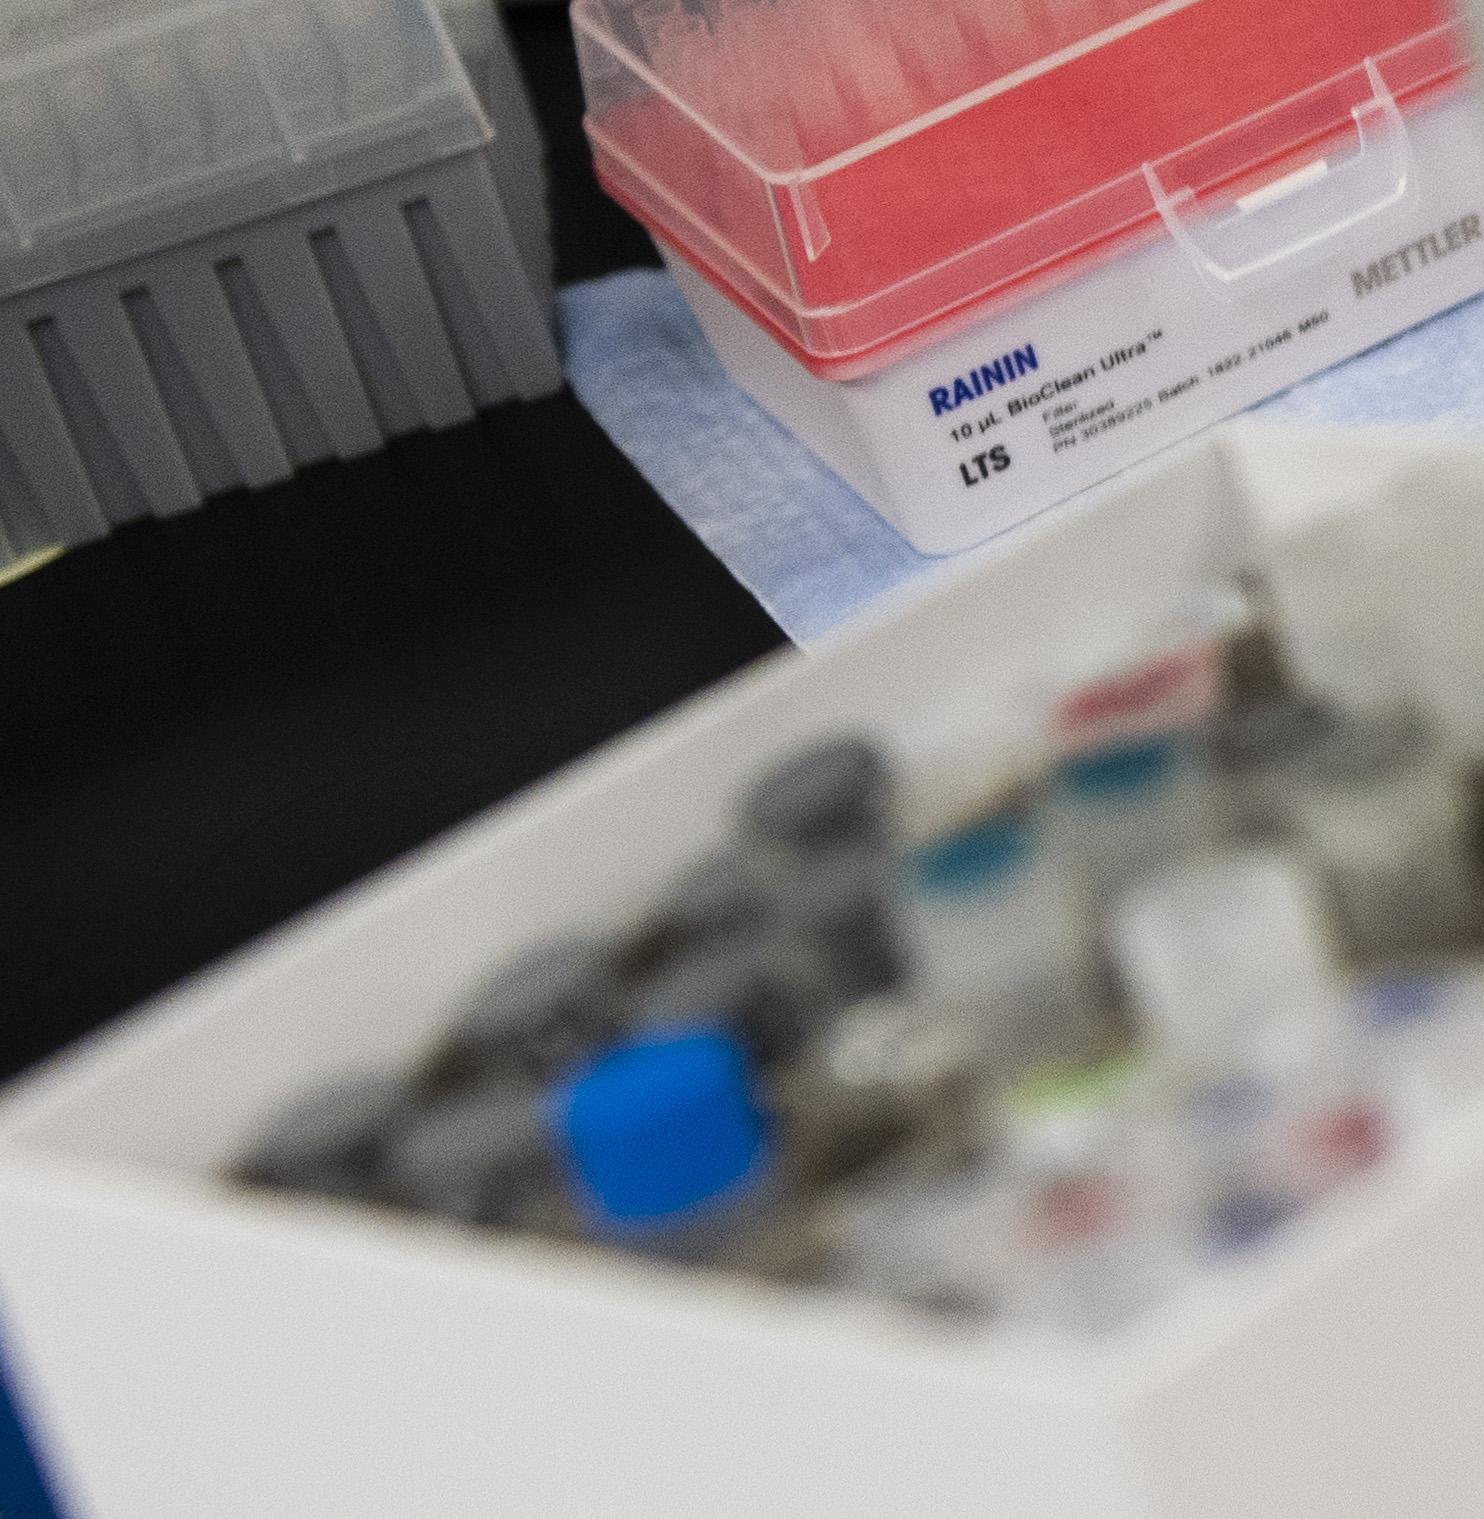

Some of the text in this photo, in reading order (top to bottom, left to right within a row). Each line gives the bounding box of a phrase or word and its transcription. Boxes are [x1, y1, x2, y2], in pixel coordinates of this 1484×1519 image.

[1351, 213, 1483, 298] METTLER
[928, 343, 1039, 416] RAININ
[951, 423, 973, 443] 10
[1006, 366, 1096, 417] BioClean
[1157, 374, 1201, 402] Batch
[1049, 398, 1115, 437] Sterilized
[959, 445, 1012, 487] LTS
